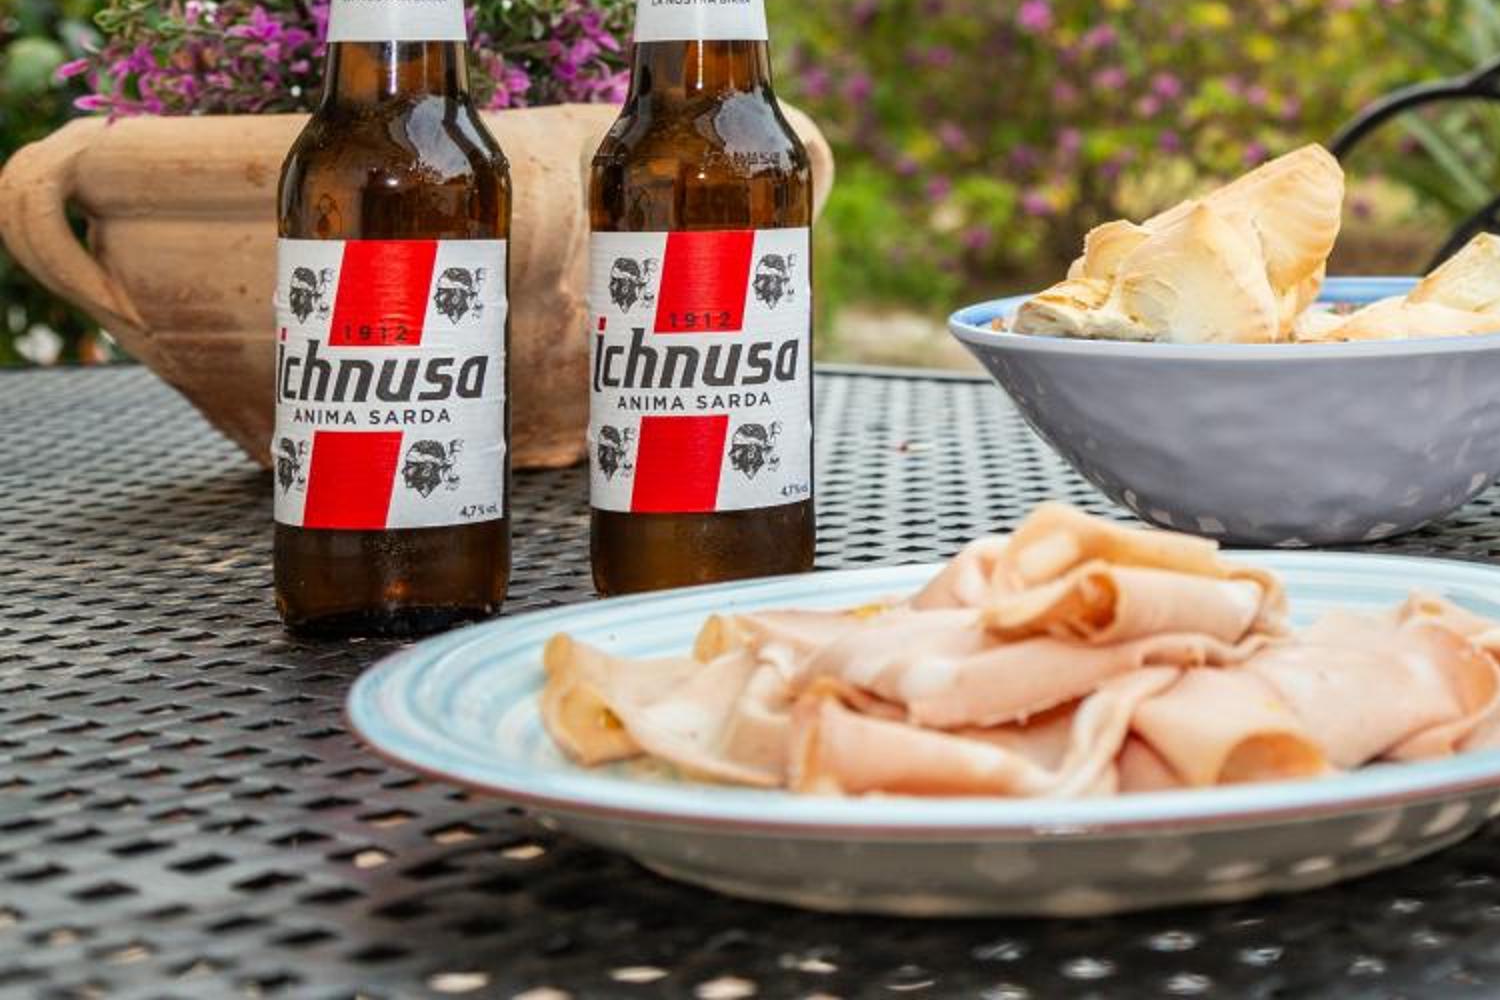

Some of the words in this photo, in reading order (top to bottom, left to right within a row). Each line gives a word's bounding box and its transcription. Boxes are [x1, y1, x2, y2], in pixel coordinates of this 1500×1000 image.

[669, 312, 731, 329] 1912
[343, 323, 408, 341] 1912
[593, 317, 799, 392] ichnusa
[277, 327, 489, 405] ichnusa
[618, 396, 684, 410] ANIMA
[697, 392, 771, 409] SARDA
[294, 409, 357, 424] ANIMA
[369, 408, 451, 424] SARDA
